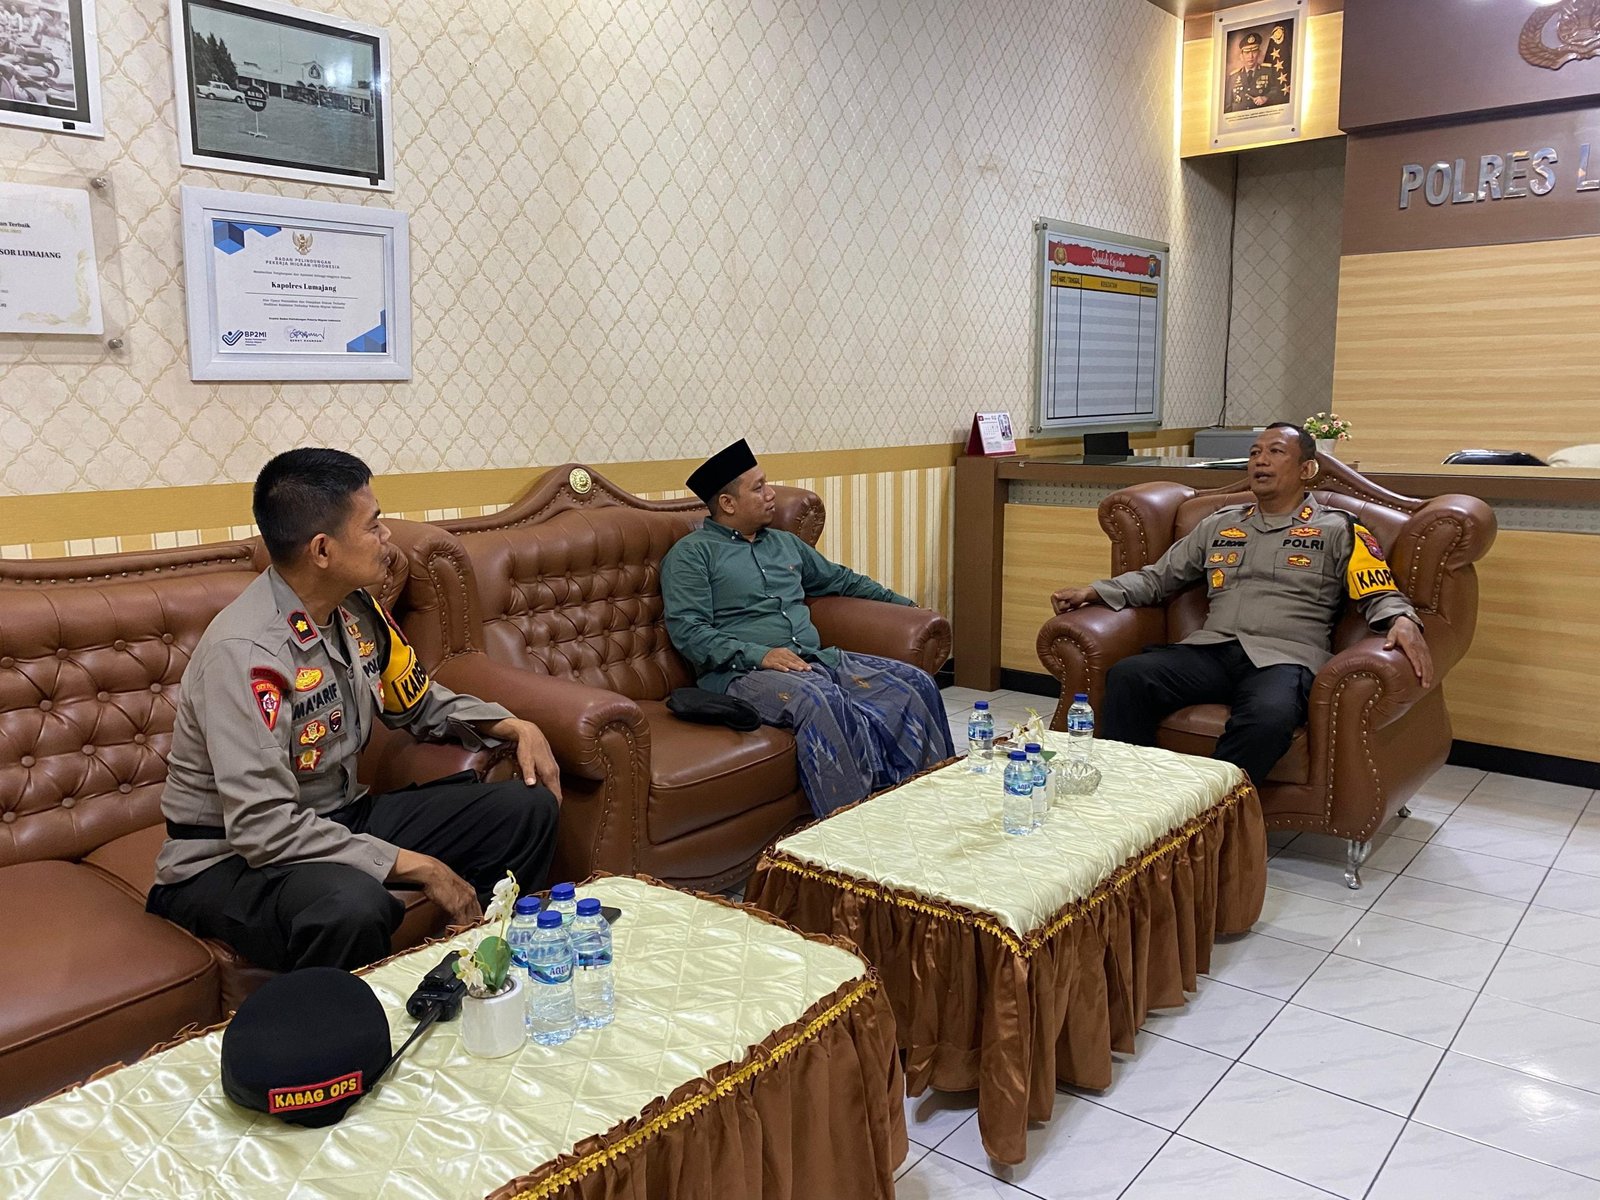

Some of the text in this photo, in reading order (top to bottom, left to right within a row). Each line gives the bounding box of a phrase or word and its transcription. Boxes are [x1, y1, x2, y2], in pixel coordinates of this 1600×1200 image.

[1399, 147, 1558, 209] POLRES
[18, 250, 61, 258] LUMAJANG
[271, 281, 337, 292] Kapolres Lumajang
[244, 330, 267, 338] BP2MI
[1282, 539, 1325, 551] POLRI
[293, 683, 338, 721] MA'ARIF
[274, 1077, 357, 1108] KABAG OPS
